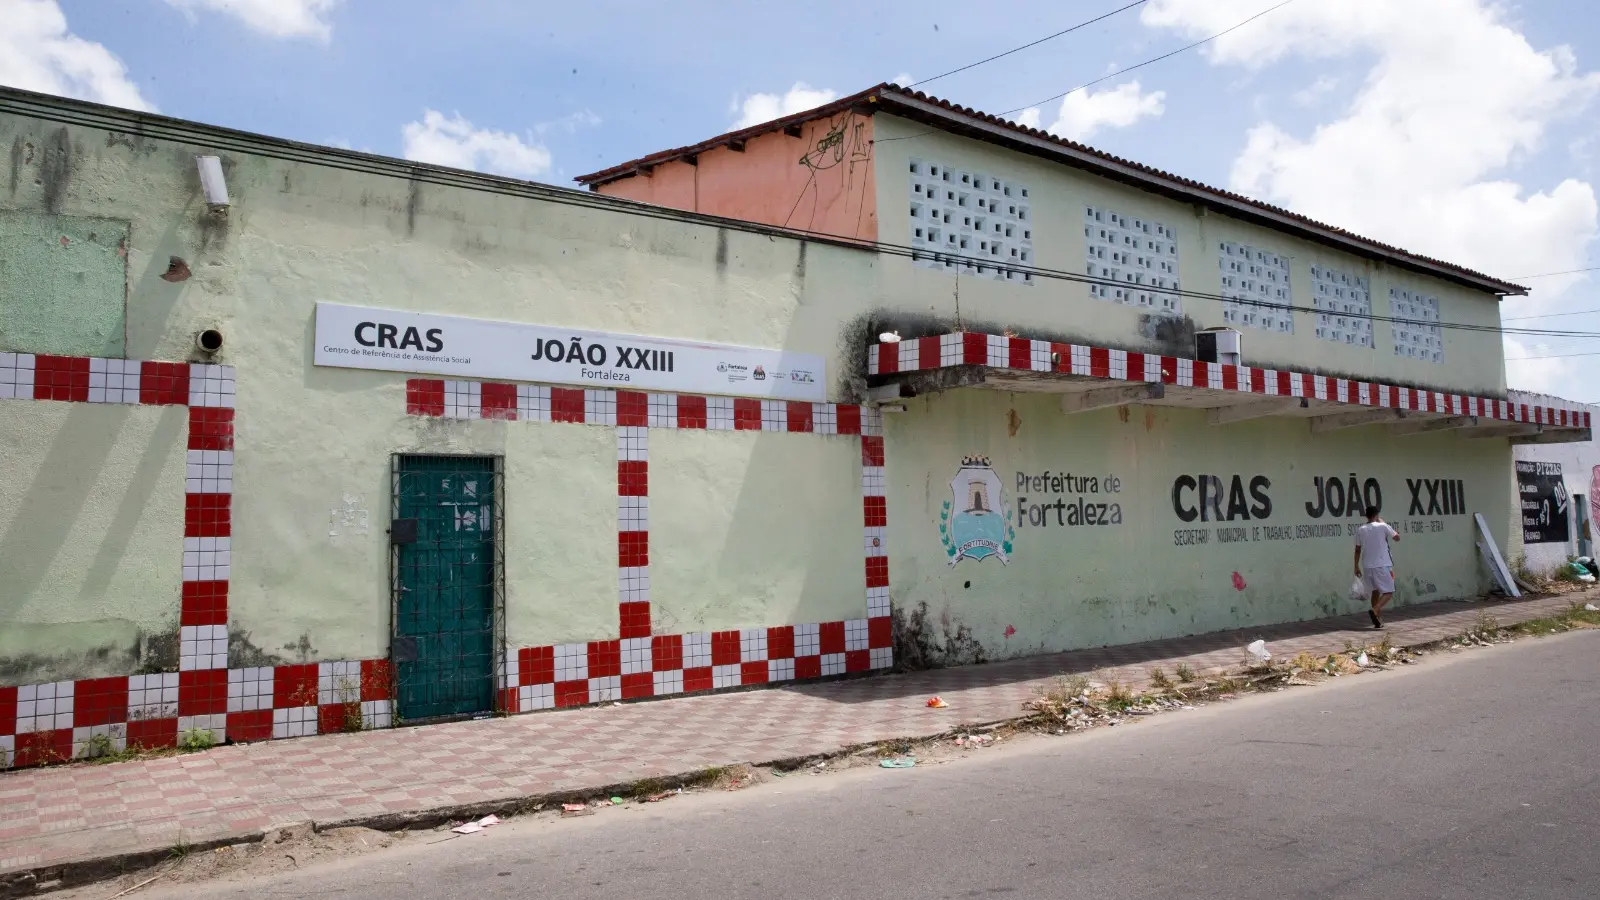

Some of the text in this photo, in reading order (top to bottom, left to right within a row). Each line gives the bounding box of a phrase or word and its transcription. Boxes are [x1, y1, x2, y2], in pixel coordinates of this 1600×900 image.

[323, 345, 471, 364] Centro de Referência de Assistência Social
[354, 321, 674, 372] CRAS JOÃO XXIII
[581, 368, 631, 382] Fortaleza
[1536, 462, 1560, 476] PIZZAS
[1016, 470, 1121, 494] Prefeitura de
[1171, 472, 1466, 523] CRAS JOÃO XXIII
[1017, 496, 1122, 528] Fortaleza
[1216, 527, 1249, 543] MUNICIPAL
[1252, 525, 1260, 541] DE
[958, 539, 999, 555] FORTITUDINE
